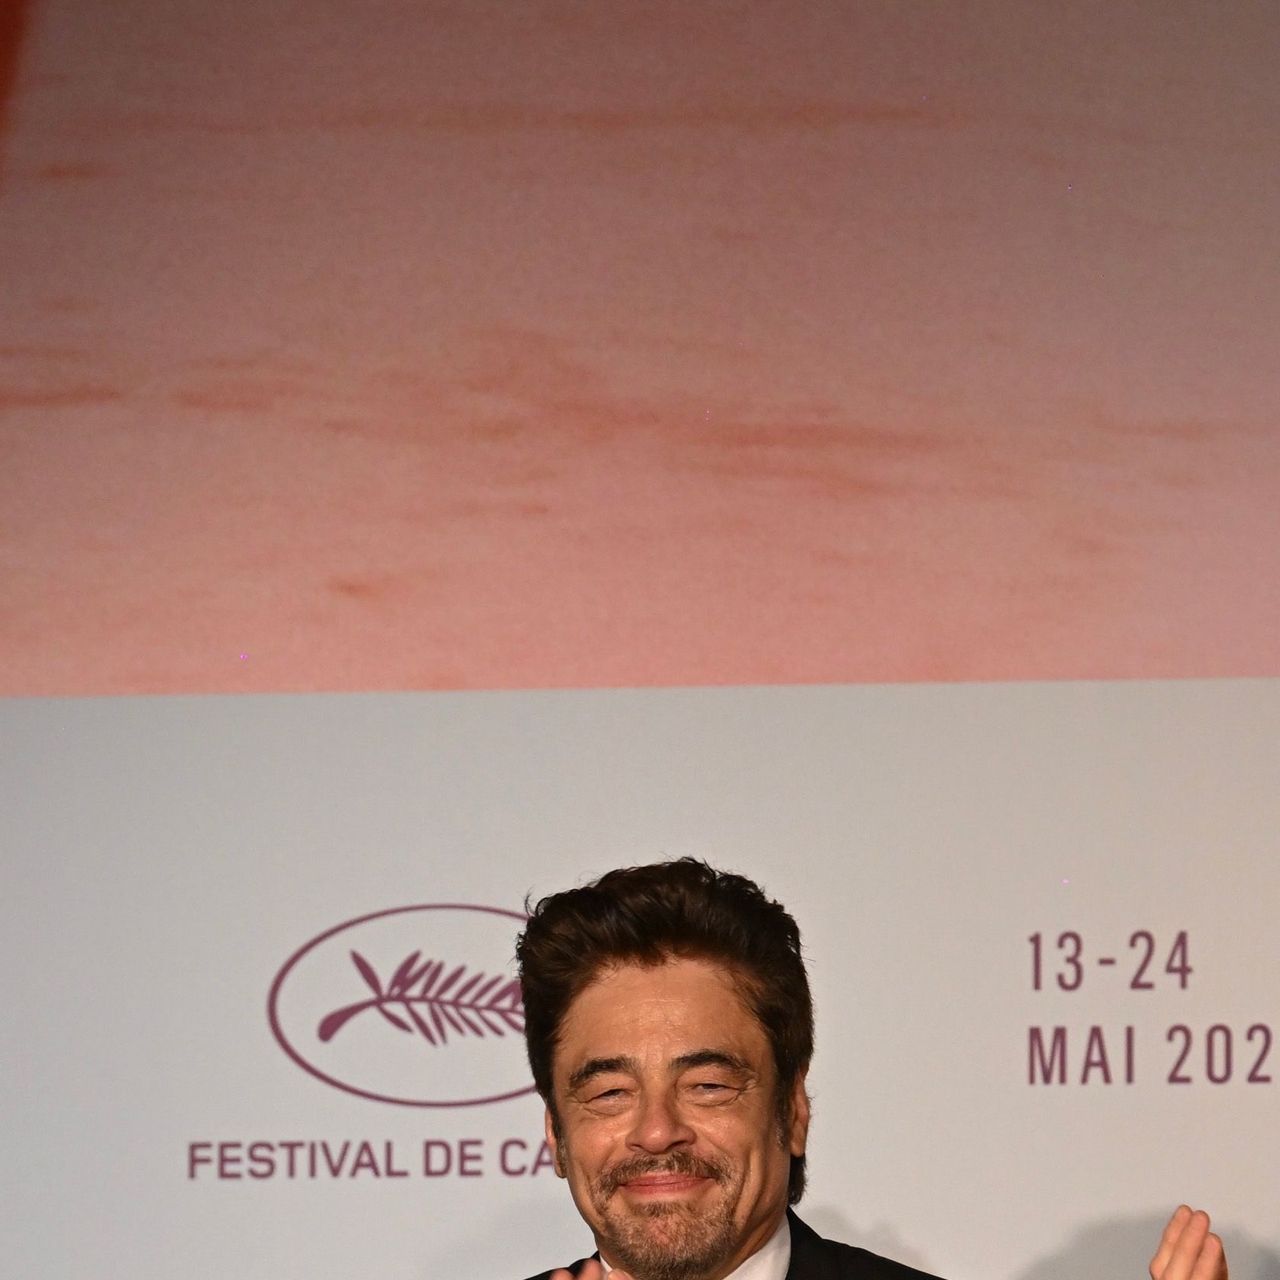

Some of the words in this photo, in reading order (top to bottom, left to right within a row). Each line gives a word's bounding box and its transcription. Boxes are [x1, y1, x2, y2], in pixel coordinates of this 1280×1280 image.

[1028, 929, 1194, 992] 13-24
[1028, 1025, 1136, 1087] MAI
[187, 1140, 410, 1180] FESTIVAL
[423, 1139, 484, 1178] DE
